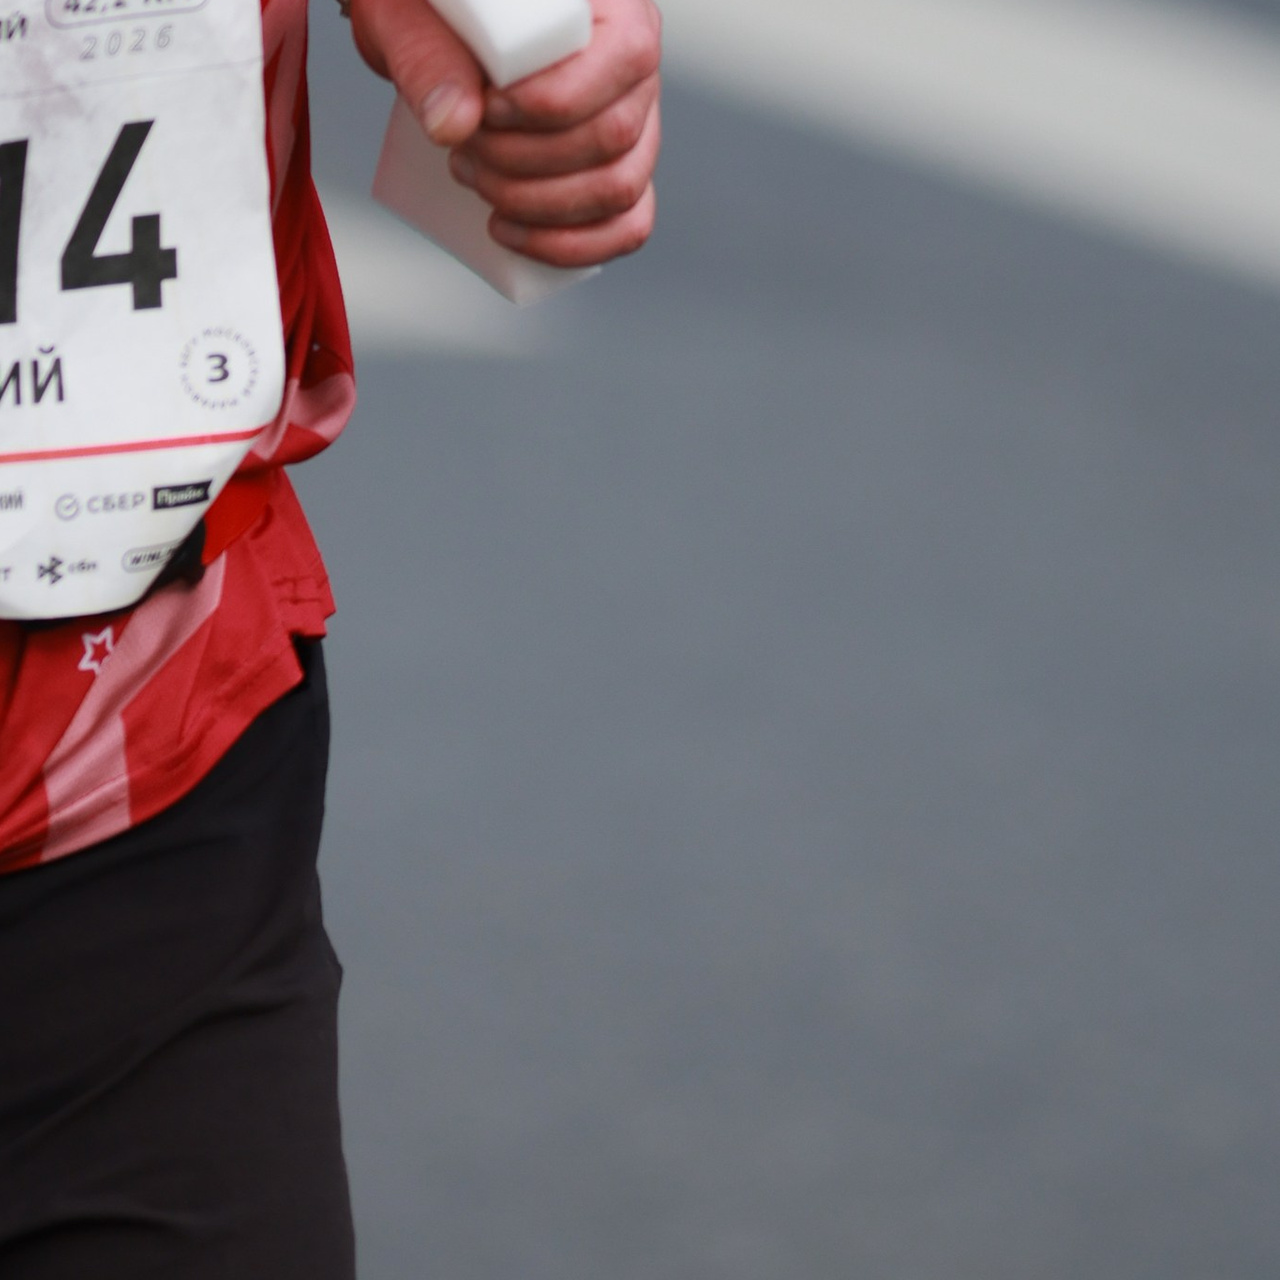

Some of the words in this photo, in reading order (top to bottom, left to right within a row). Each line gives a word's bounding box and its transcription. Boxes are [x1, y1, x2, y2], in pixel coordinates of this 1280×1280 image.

[78, 23, 176, 61] 2026
[206, 353, 230, 383] 3
[86, 492, 146, 515] СБЕР
